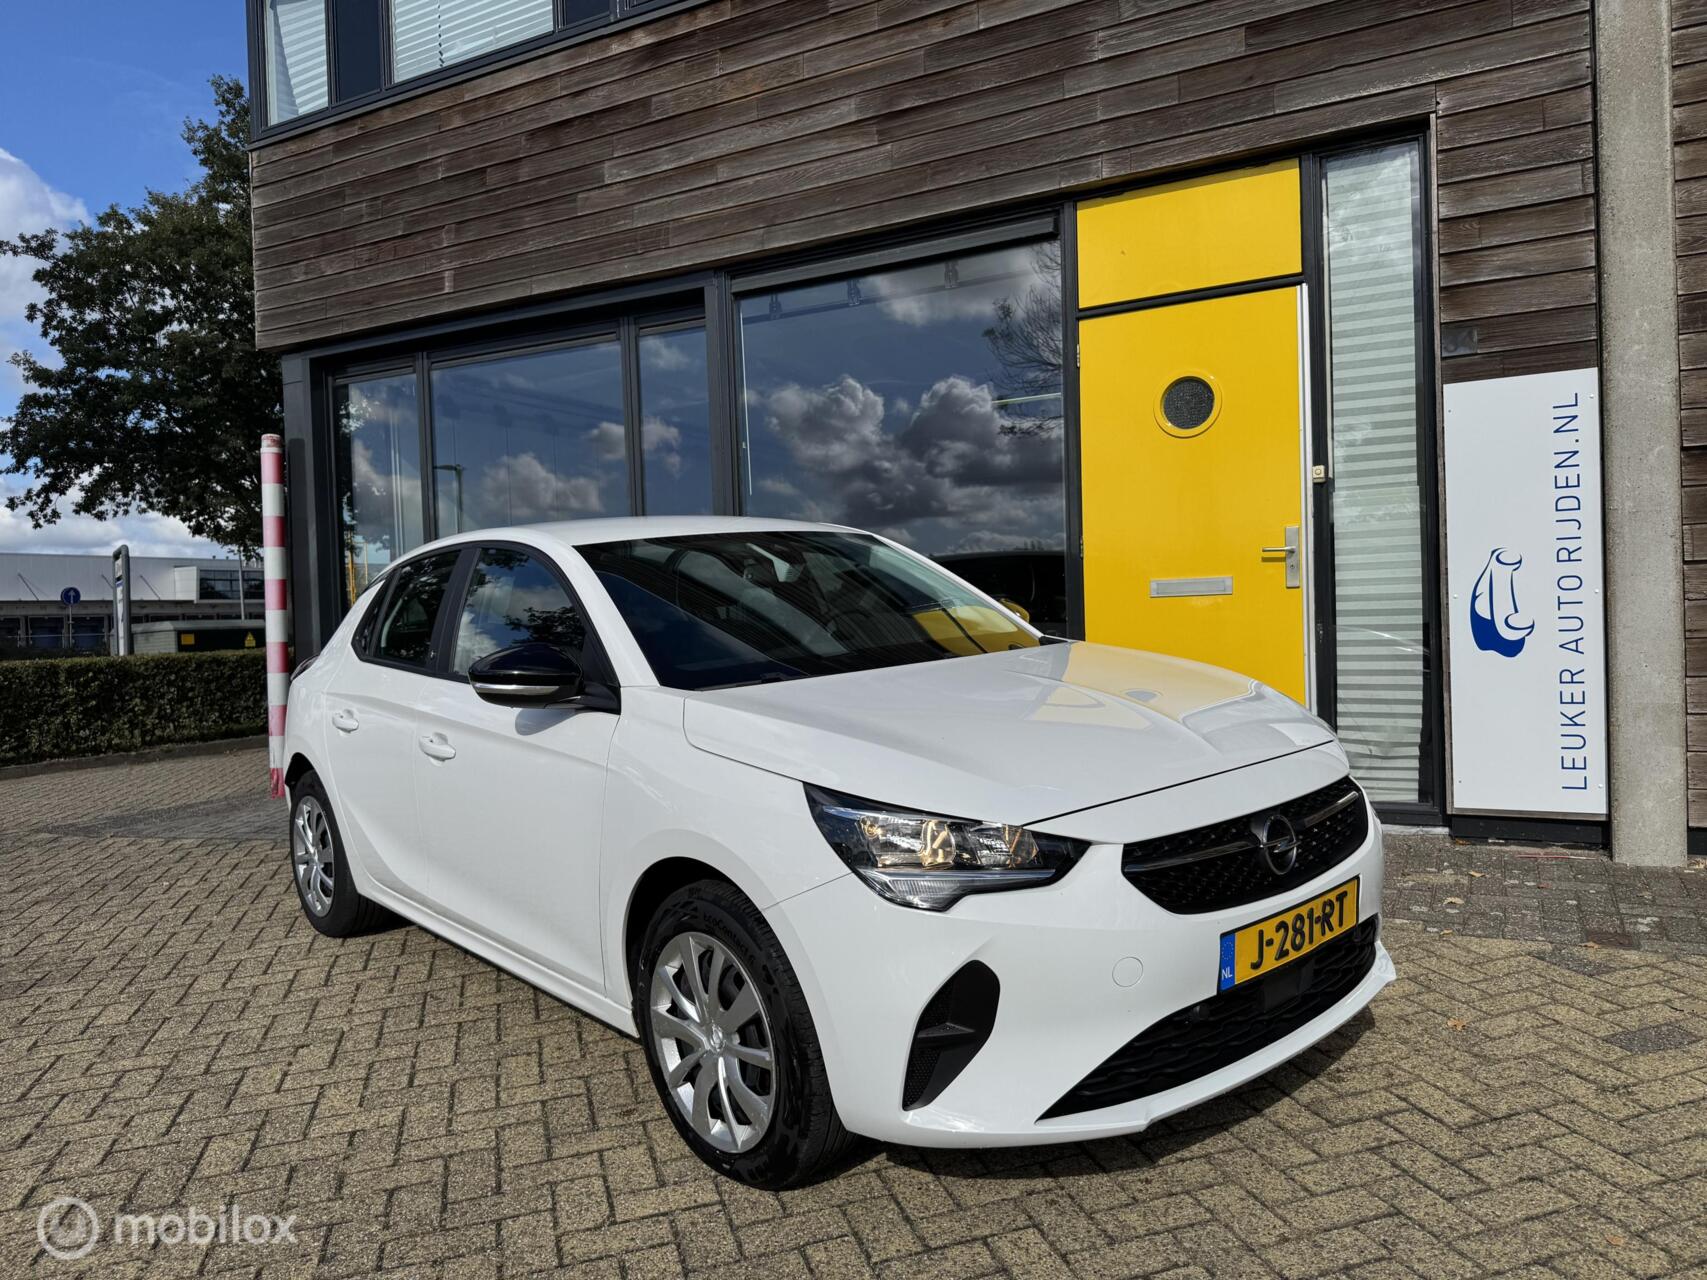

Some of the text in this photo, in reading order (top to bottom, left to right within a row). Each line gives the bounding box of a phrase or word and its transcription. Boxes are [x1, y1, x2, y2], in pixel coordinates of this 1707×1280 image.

[1559, 669, 1587, 790] LEUKER
[1250, 890, 1348, 970] J-281-RT
[1221, 966, 1233, 980] NL
